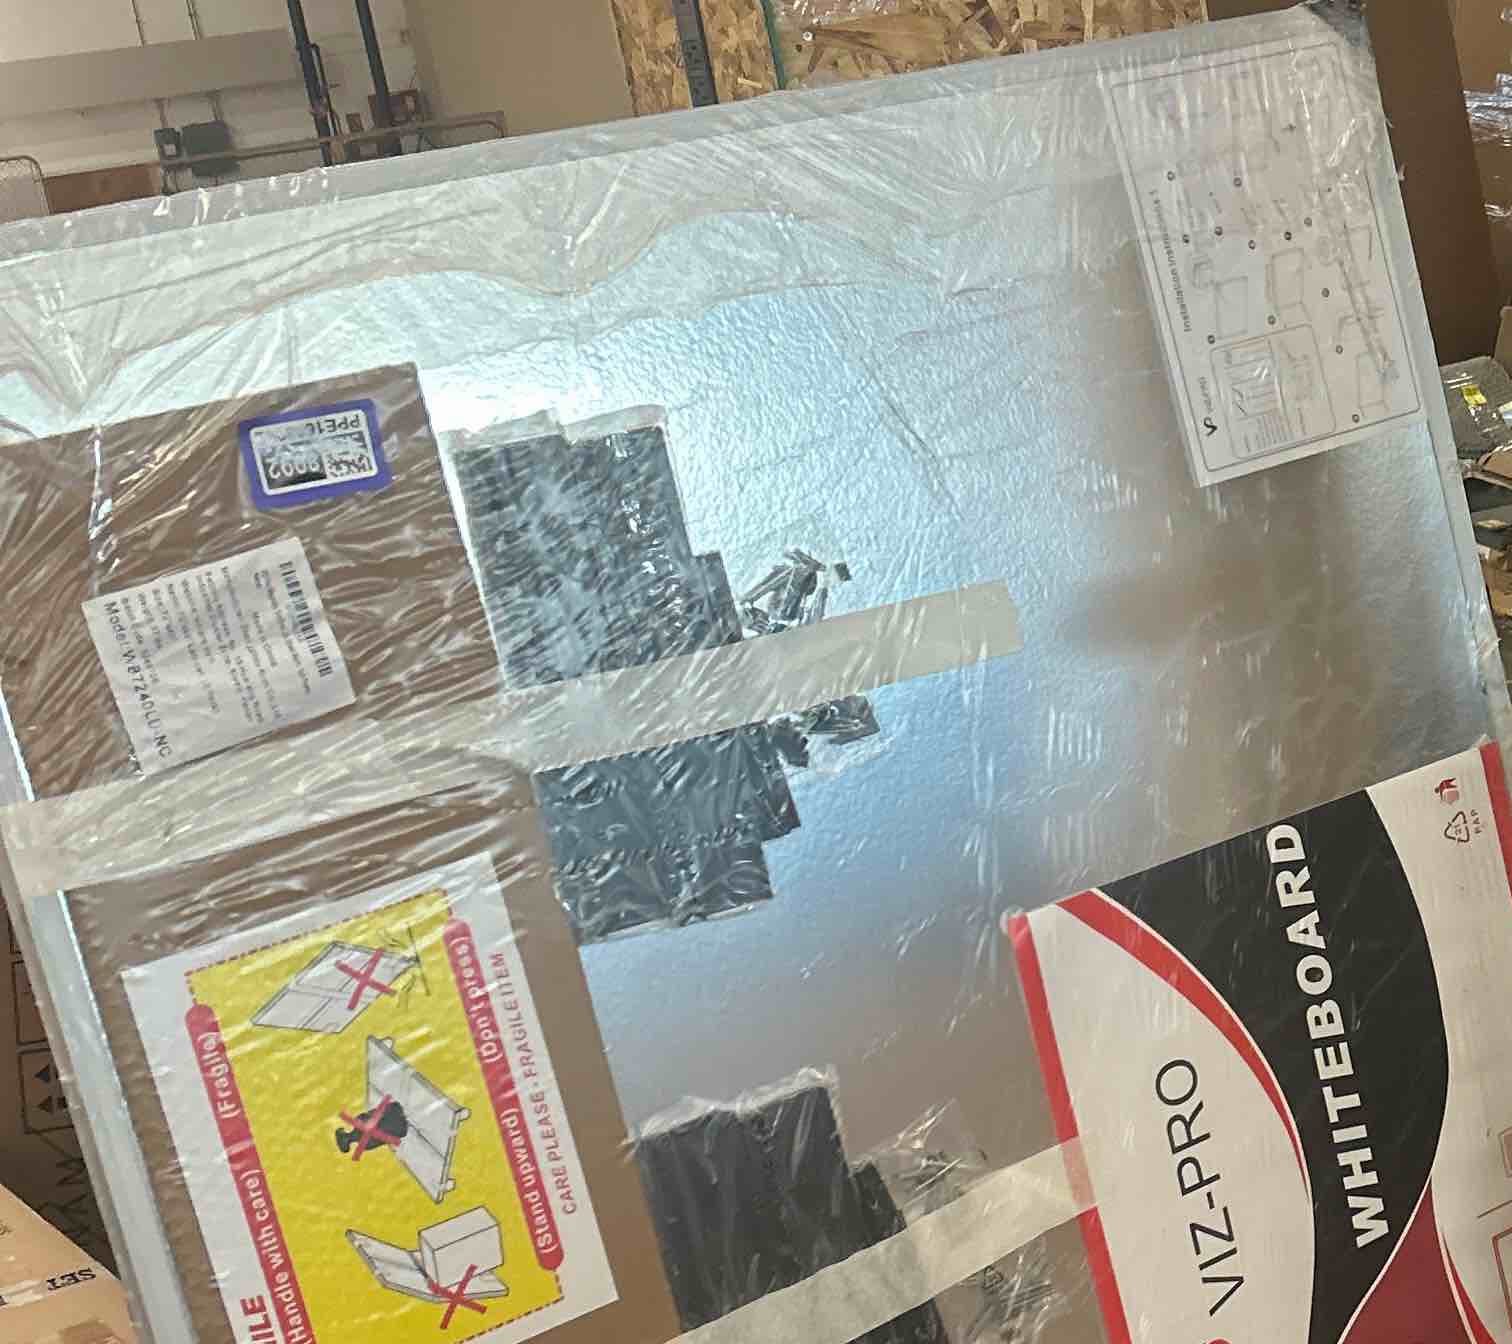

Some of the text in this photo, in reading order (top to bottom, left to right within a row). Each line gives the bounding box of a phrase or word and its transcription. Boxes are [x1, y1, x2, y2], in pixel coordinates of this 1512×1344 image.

[199, 1030, 242, 1119] (Fragile)
[501, 1000, 538, 1080] FRAGILE
[1266, 822, 1390, 1249] WHITEBOARD
[529, 1091, 561, 1163] PLEASE
[238, 1167, 268, 1222] care)
[500, 1107, 557, 1256] (Stand upward)
[549, 1164, 577, 1215] CARE
[1154, 1057, 1245, 1317] VIZ-PRO
[257, 1222, 288, 1273] with
